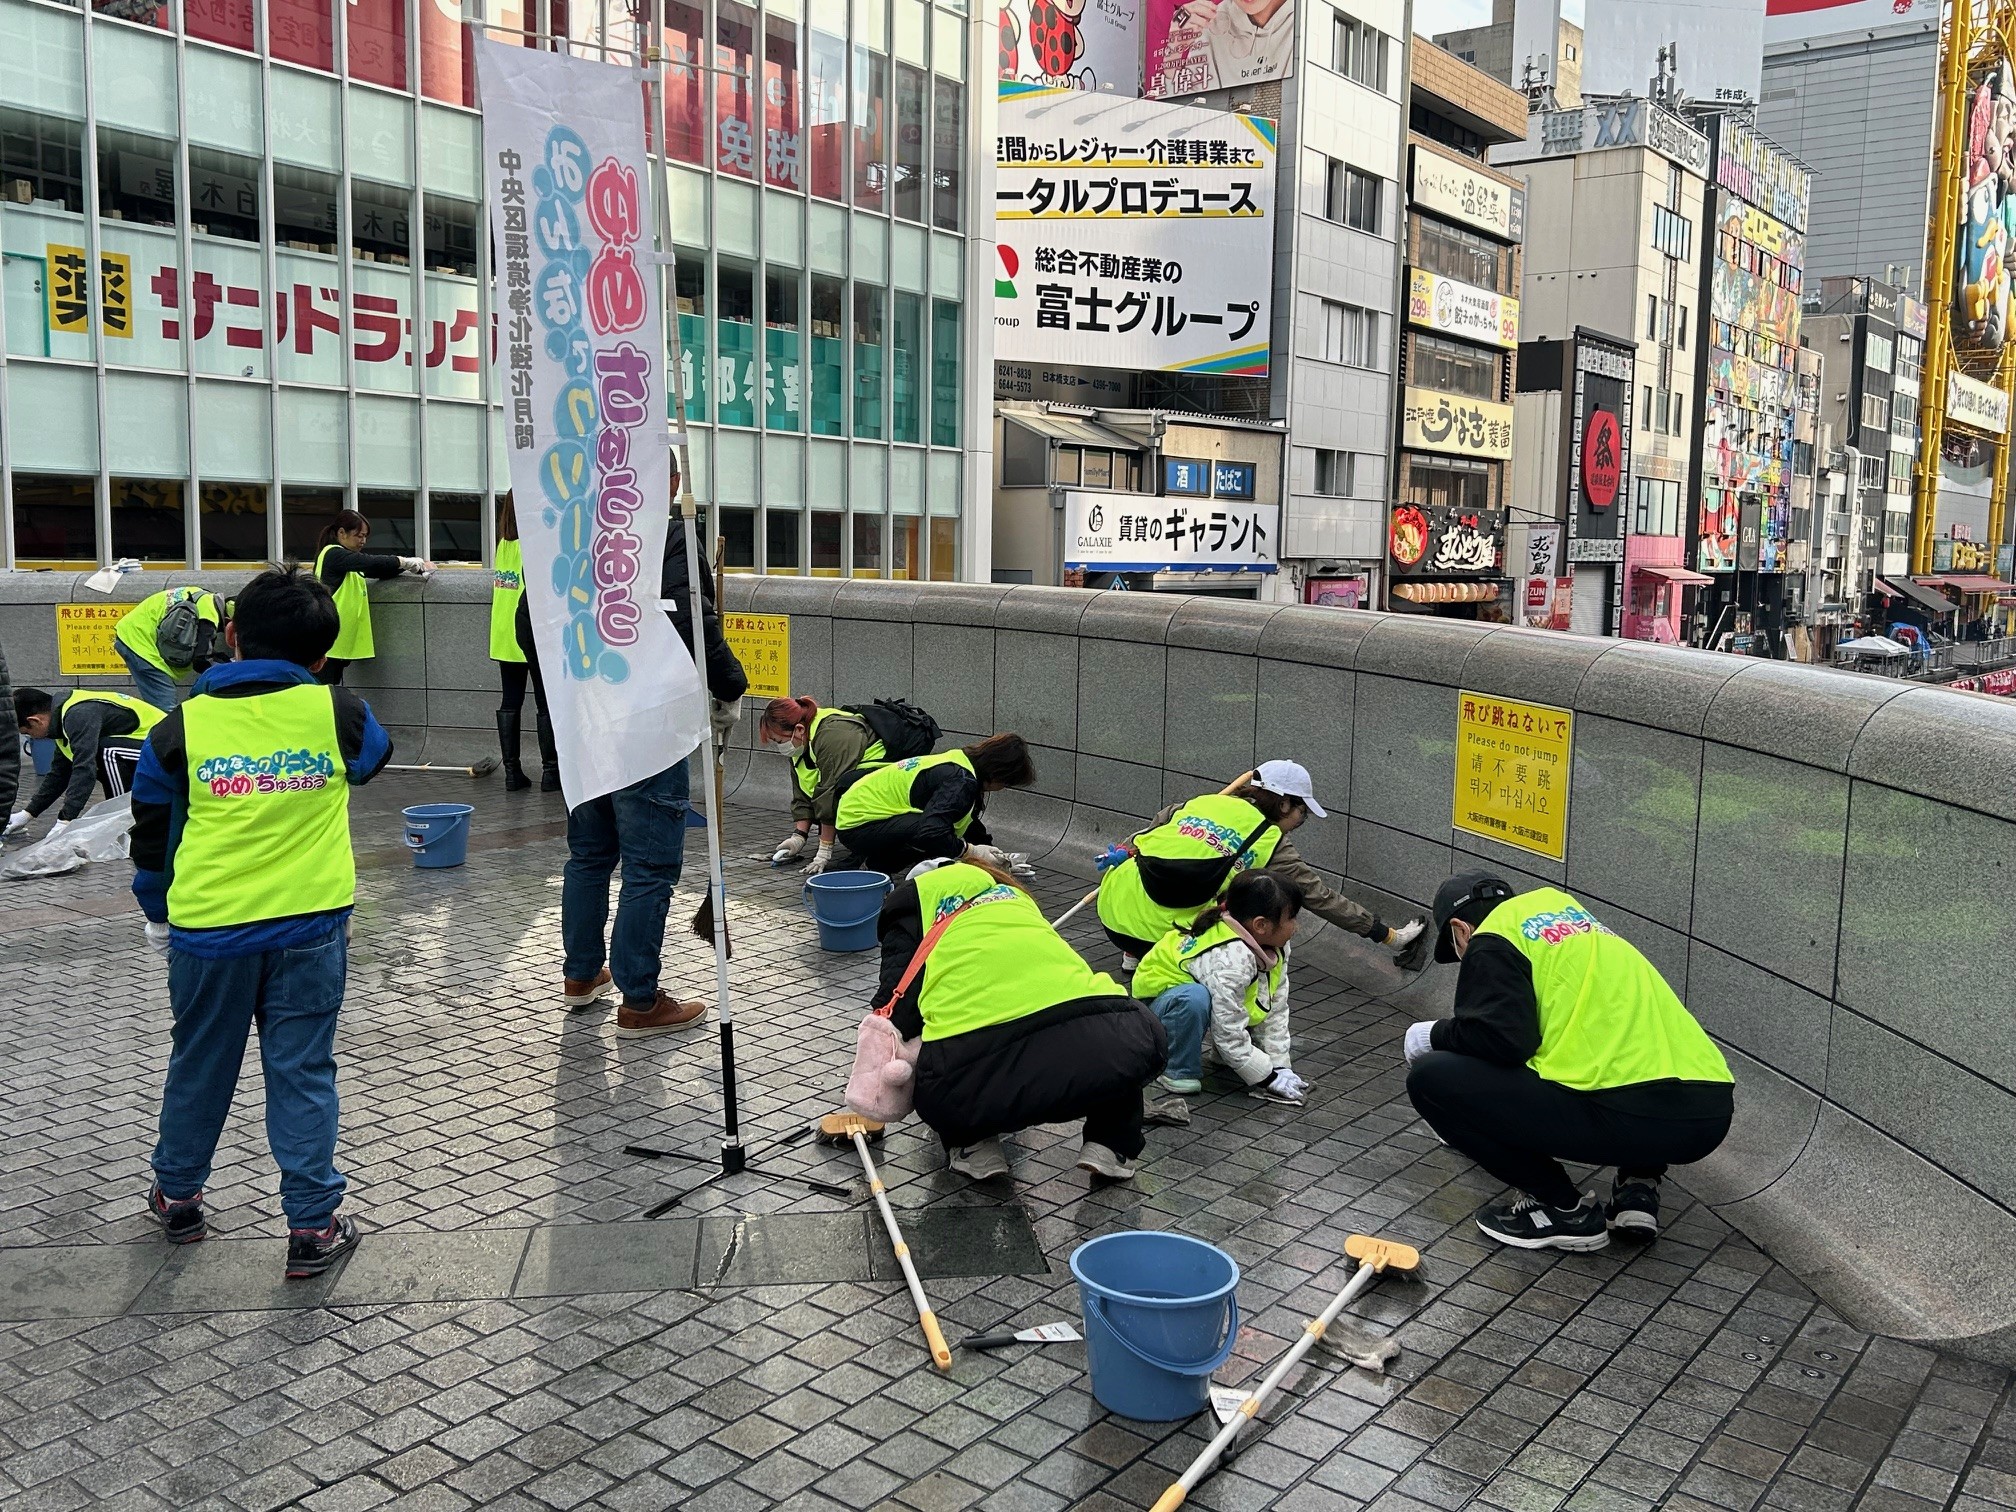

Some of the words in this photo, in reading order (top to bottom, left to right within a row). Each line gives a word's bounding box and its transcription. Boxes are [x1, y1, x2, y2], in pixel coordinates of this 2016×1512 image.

[719, 113, 800, 187] 免税
[1035, 246, 1183, 285] 総合不動産業の
[54, 253, 127, 331] 薬
[1036, 283, 1259, 341] 富士グループ
[1042, 371, 1076, 387] 日本橋支店
[1421, 397, 1487, 449] うなぎ
[1176, 464, 1190, 489] 酒
[1215, 468, 1242, 491] たばこ
[1077, 536, 1113, 548] GALAXIE
[1118, 507, 1267, 553] 賃貸のギャラント
[1436, 525, 1496, 569] ずんどう屋
[1528, 586, 1545, 597] ZUN
[742, 636, 750, 644] do
[752, 638, 763, 646] not
[765, 639, 782, 648] jump
[744, 662, 779, 676] 마십시오
[1462, 700, 1567, 739] 飛び跳ねないで
[1467, 732, 1496, 749] Please
[1499, 740, 1511, 751] do
[1514, 744, 1529, 757] not
[1532, 746, 1558, 766] jump
[1470, 776, 1493, 801] 뛰지
[1500, 785, 1550, 815] 마십시오
